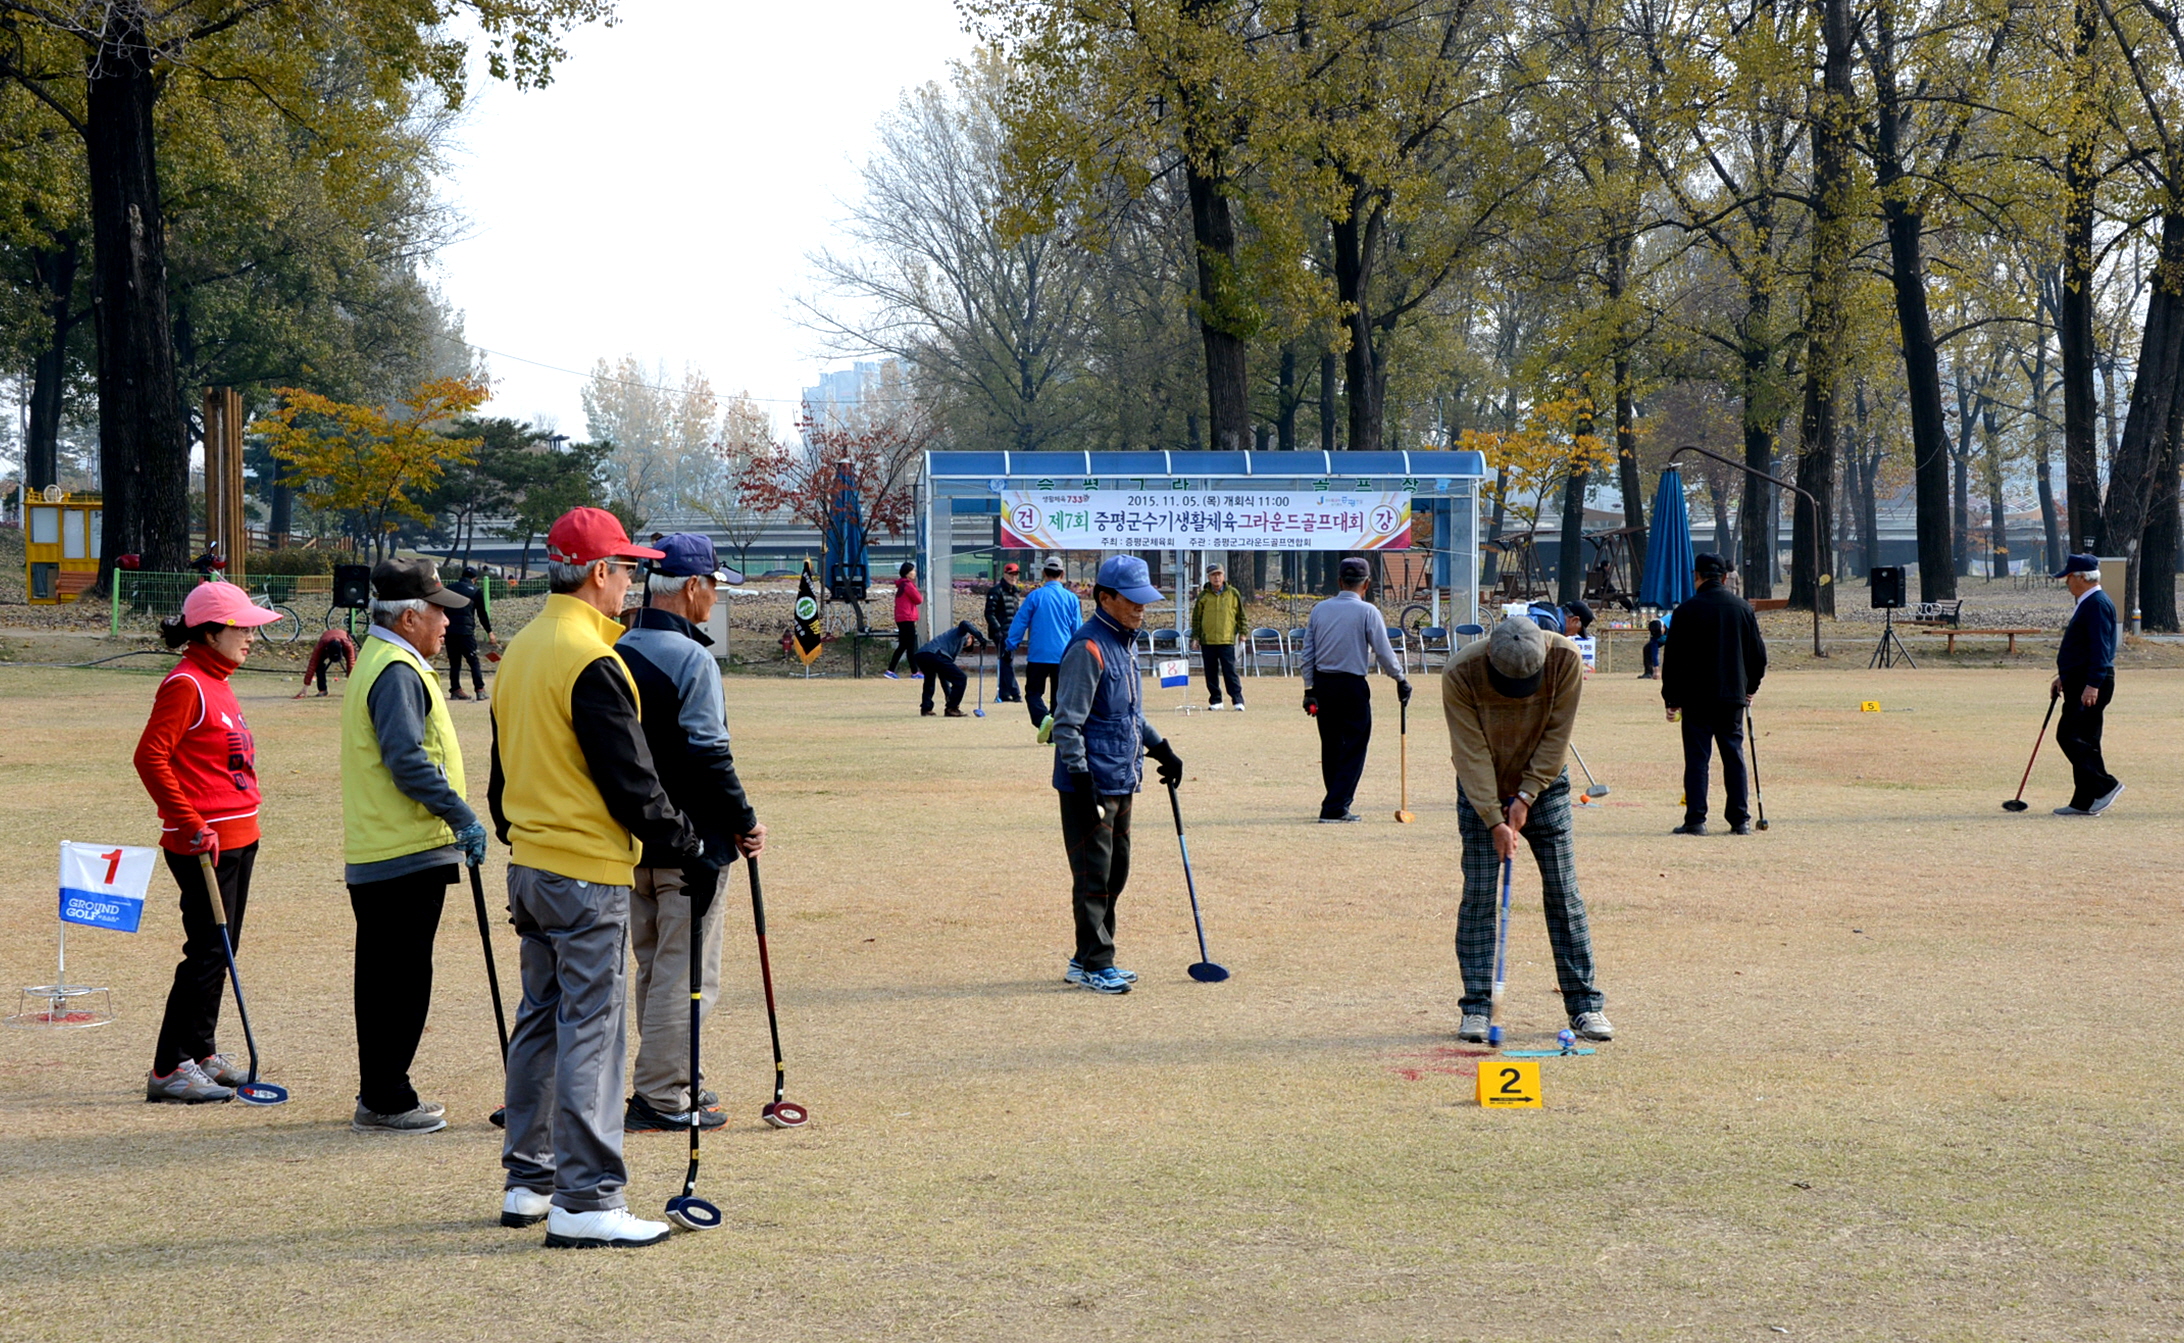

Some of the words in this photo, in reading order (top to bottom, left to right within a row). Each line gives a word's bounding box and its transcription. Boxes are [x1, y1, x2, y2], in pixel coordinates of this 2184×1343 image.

[1128, 496, 1159, 506] 2015.
[1163, 496, 1179, 506] 11.
[1182, 496, 1200, 507] 05.
[1203, 495, 1221, 508] (목)
[1224, 496, 1255, 507] 개회식
[1259, 496, 1289, 507] 11:00
[1017, 508, 1033, 528] 건
[1048, 510, 1090, 532] 제7회
[1376, 510, 1393, 530] 강
[1125, 537, 1175, 547] 증평군체육회
[1167, 662, 1178, 676] 8
[100, 848, 123, 885] 1
[66, 907, 98, 921] GOLF
[68, 898, 120, 915] GROUND
[1499, 1067, 1522, 1094] 2
